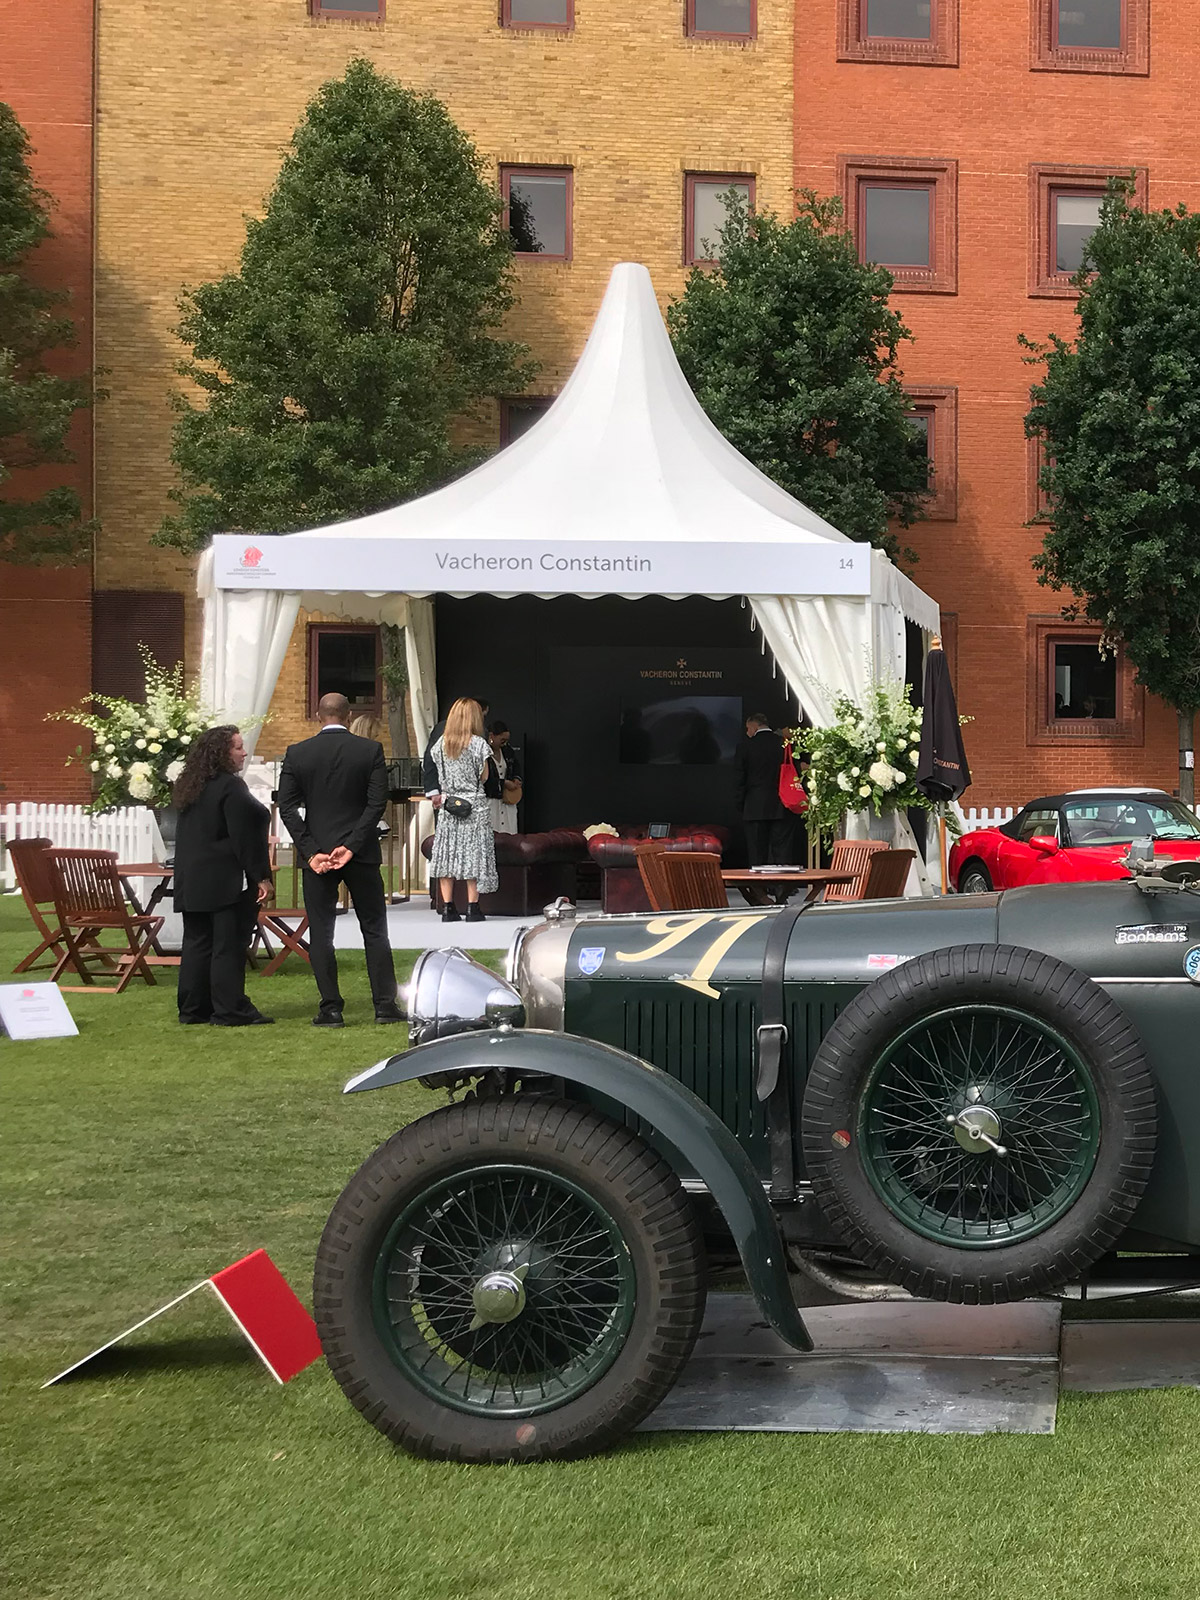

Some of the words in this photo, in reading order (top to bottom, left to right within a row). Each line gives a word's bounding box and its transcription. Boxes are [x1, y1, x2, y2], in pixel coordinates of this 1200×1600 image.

[435, 552, 533, 570] Vacheron
[539, 553, 652, 572] Constantin
[839, 558, 854, 569] 14
[640, 670, 678, 679] VACHERON
[679, 670, 723, 679] CONSTANTIN
[1117, 930, 1188, 943] Bonhams
